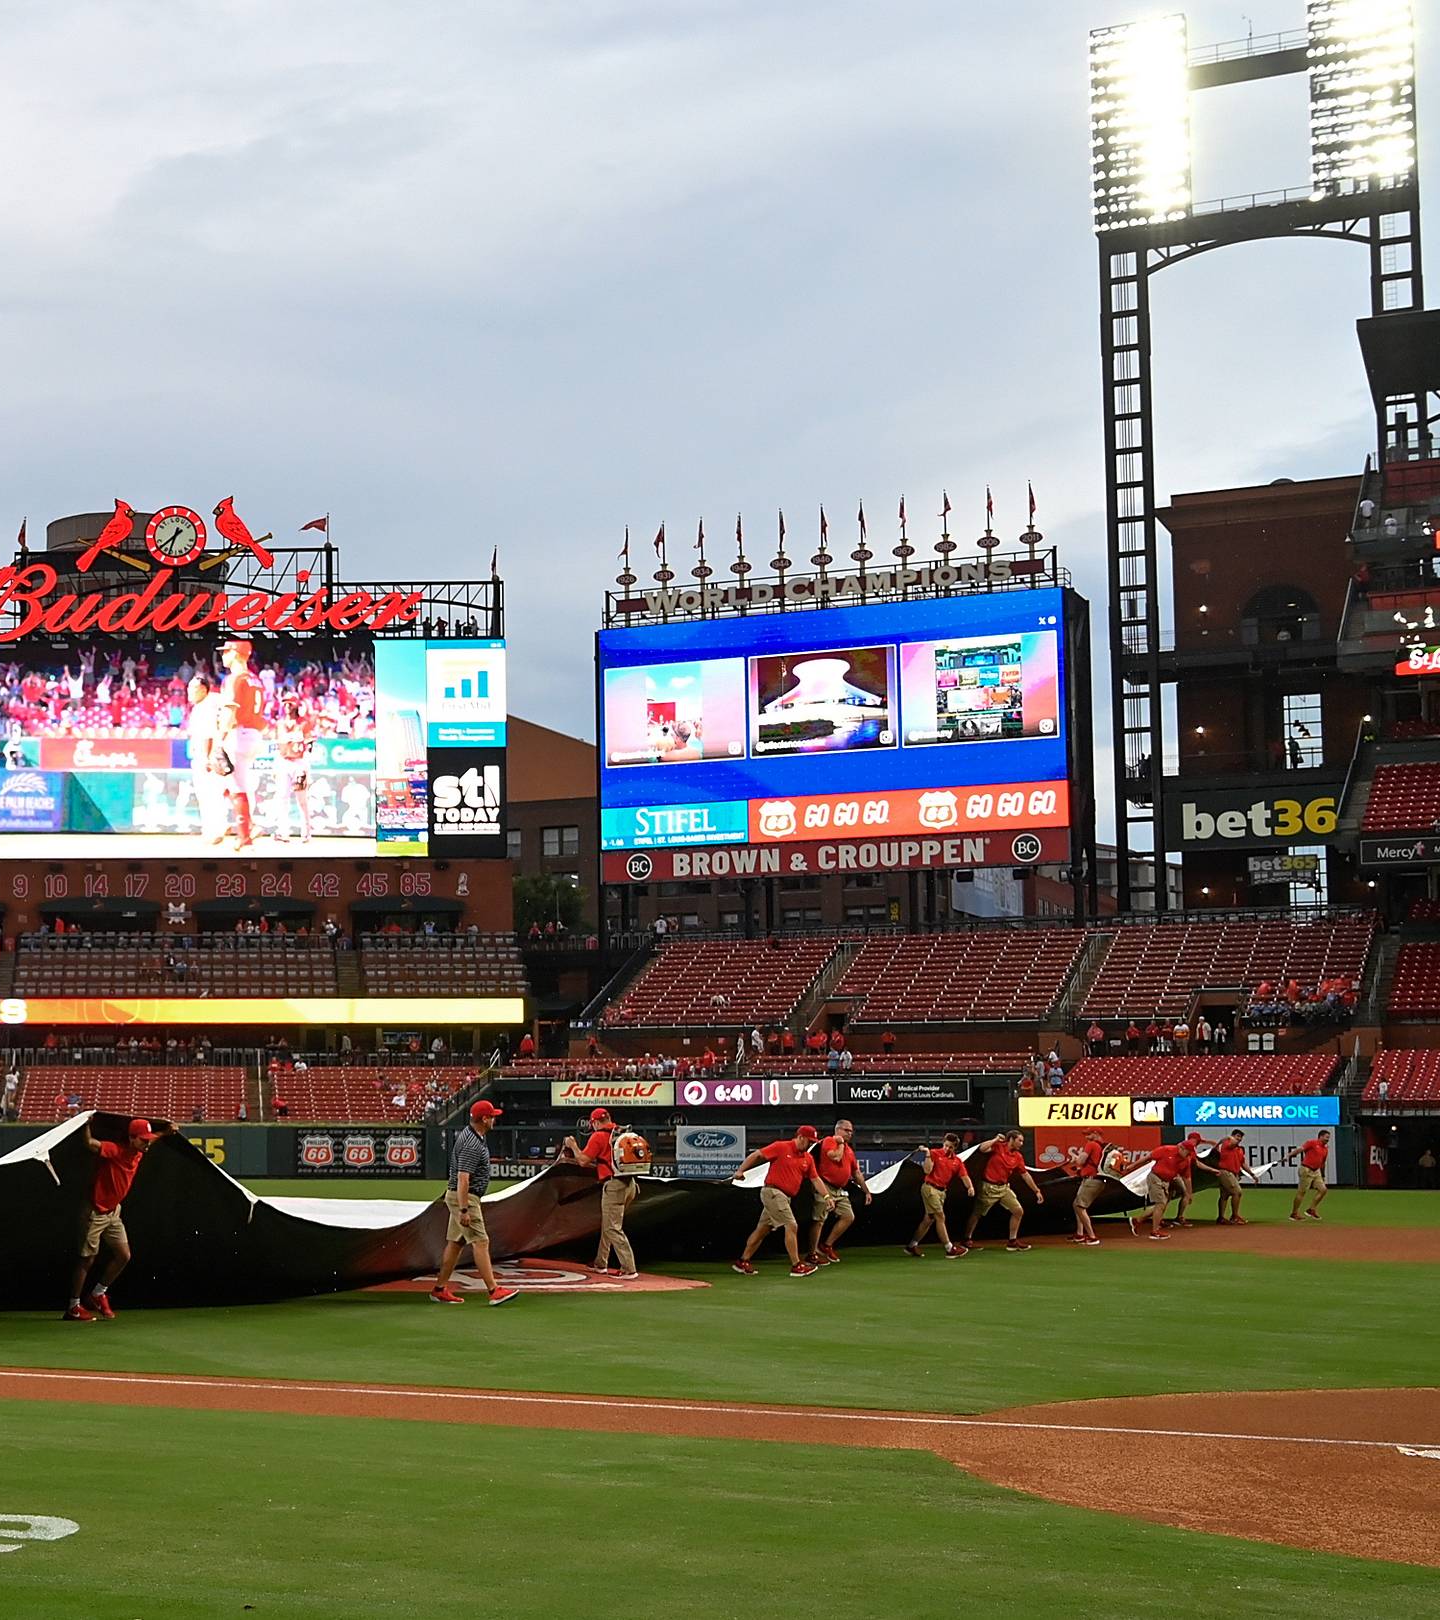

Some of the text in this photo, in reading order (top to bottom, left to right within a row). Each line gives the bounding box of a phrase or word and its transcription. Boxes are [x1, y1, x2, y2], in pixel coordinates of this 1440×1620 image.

[170, 517, 192, 529] LOUIS
[156, 538, 194, 556] CRDINALS
[644, 560, 1012, 615] WORLD CHAMPIONS
[432, 765, 500, 808] stl
[965, 793, 993, 819] GO
[997, 792, 1024, 817] GO
[433, 808, 500, 823] TODAY
[635, 808, 716, 836] STIFEL
[804, 803, 829, 828] GO
[833, 801, 859, 826] GO
[1017, 841, 1037, 855] BC
[1376, 847, 1415, 860] Mercy
[673, 837, 984, 877] BROWN & CROUPPEN
[1248, 856, 1317, 872] bet365
[631, 861, 648, 873] BC
[13, 874, 29, 898] 9
[44, 874, 68, 898] 10
[83, 874, 109, 898] 14
[124, 874, 150, 898] 17
[164, 873, 196, 897] 20
[215, 873, 246, 897] 23
[260, 873, 292, 897] 24
[308, 873, 339, 897] 42
[356, 873, 388, 897] 45
[400, 872, 431, 896] 85
[714, 1084, 753, 1102] 6:40
[850, 1087, 883, 1100] Mercy
[1047, 1103, 1118, 1120] FABICK
[1132, 1100, 1169, 1122] CAT
[694, 1132, 726, 1147] Ford
[307, 1148, 328, 1160] 66
[348, 1148, 369, 1160] 66
[390, 1148, 411, 1160] 66
[489, 1164, 536, 1177] BUSCH
